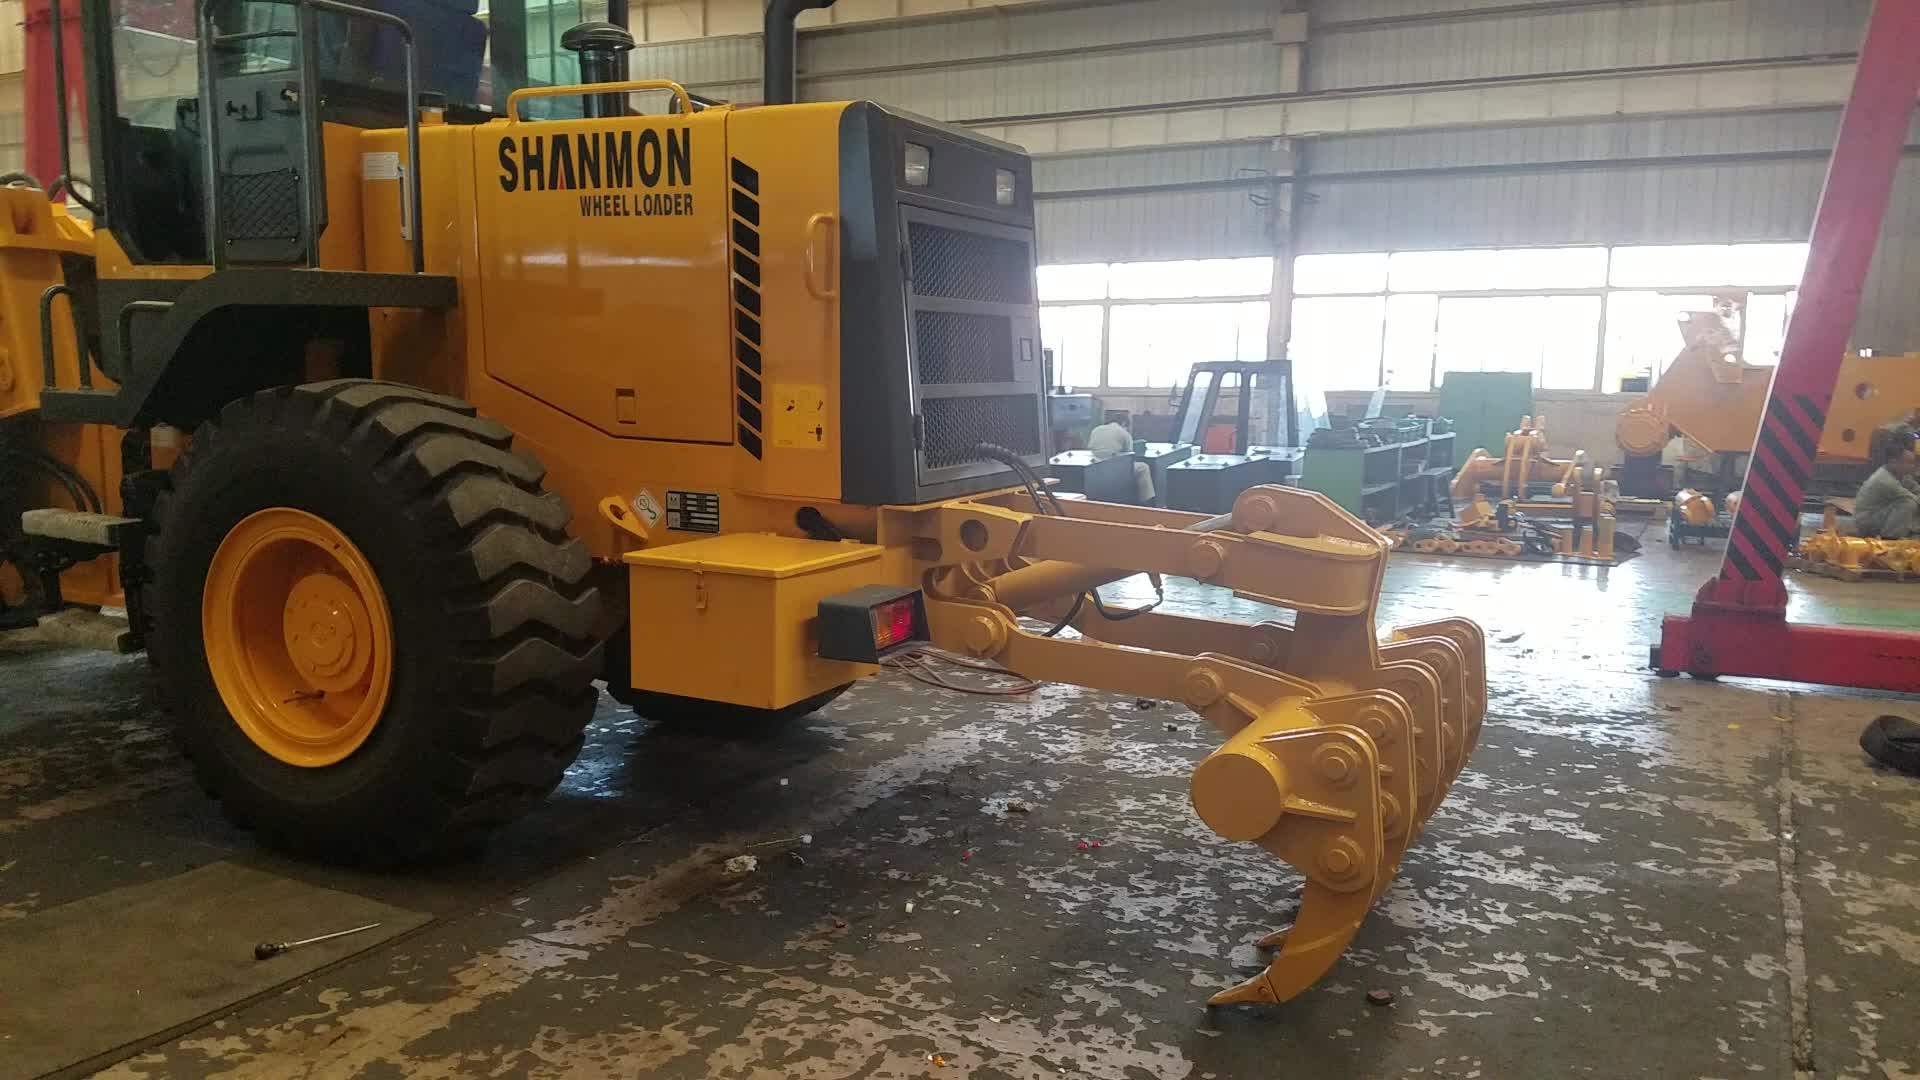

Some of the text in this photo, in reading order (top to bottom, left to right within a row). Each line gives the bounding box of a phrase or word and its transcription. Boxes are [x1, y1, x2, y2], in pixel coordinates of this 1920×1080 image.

[498, 128, 692, 192] SHANMON
[580, 193, 693, 216] WHEEL LOADER
